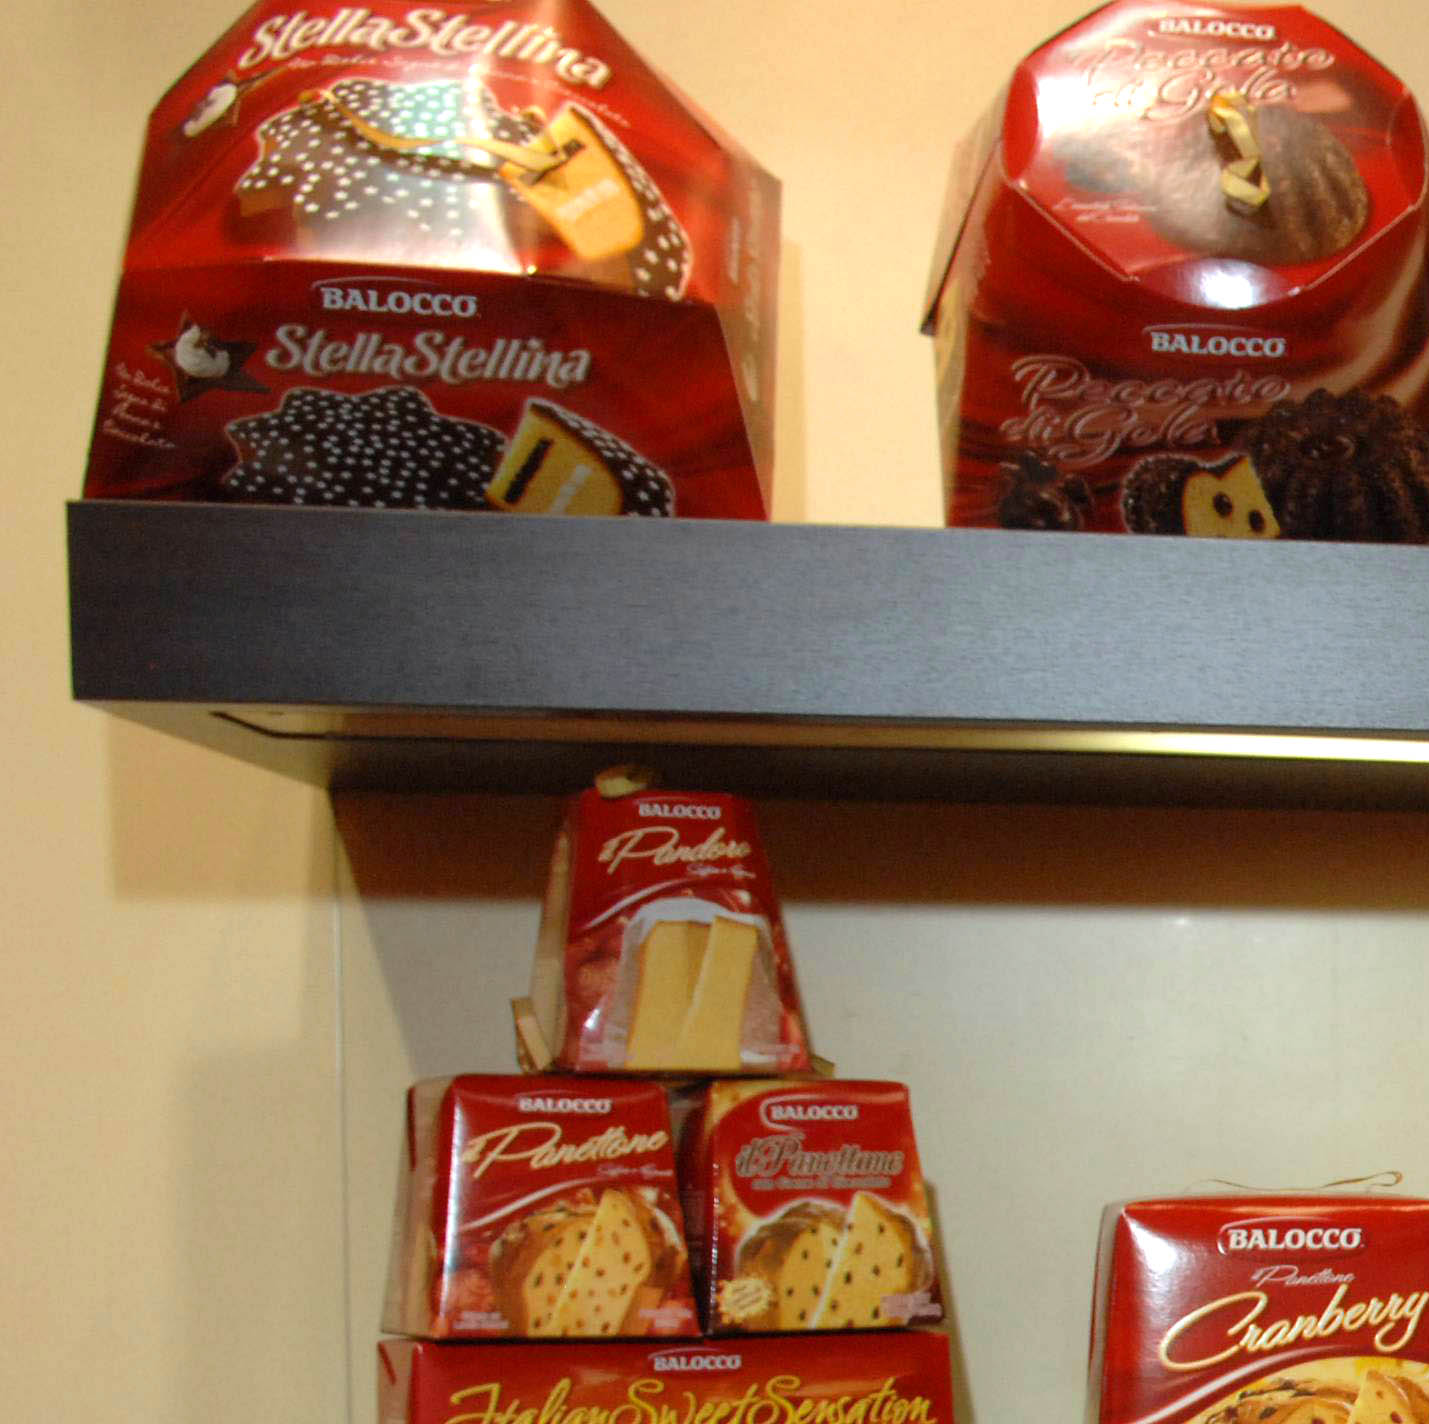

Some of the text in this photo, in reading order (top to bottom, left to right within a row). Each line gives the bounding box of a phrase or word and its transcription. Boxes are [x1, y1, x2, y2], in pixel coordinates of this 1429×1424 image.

[1158, 19, 1277, 40] BALOCCO
[322, 286, 477, 317] BALOCCO
[1151, 331, 1287, 357] BALOCCO
[639, 802, 721, 820] BALOCCO
[518, 1096, 613, 1114] BALOCCO
[770, 1105, 860, 1121] BALOCCO
[466, 1121, 669, 1179] Panettone
[1227, 1227, 1362, 1251] BALOCCO
[653, 1355, 742, 1373] BALOCCO
